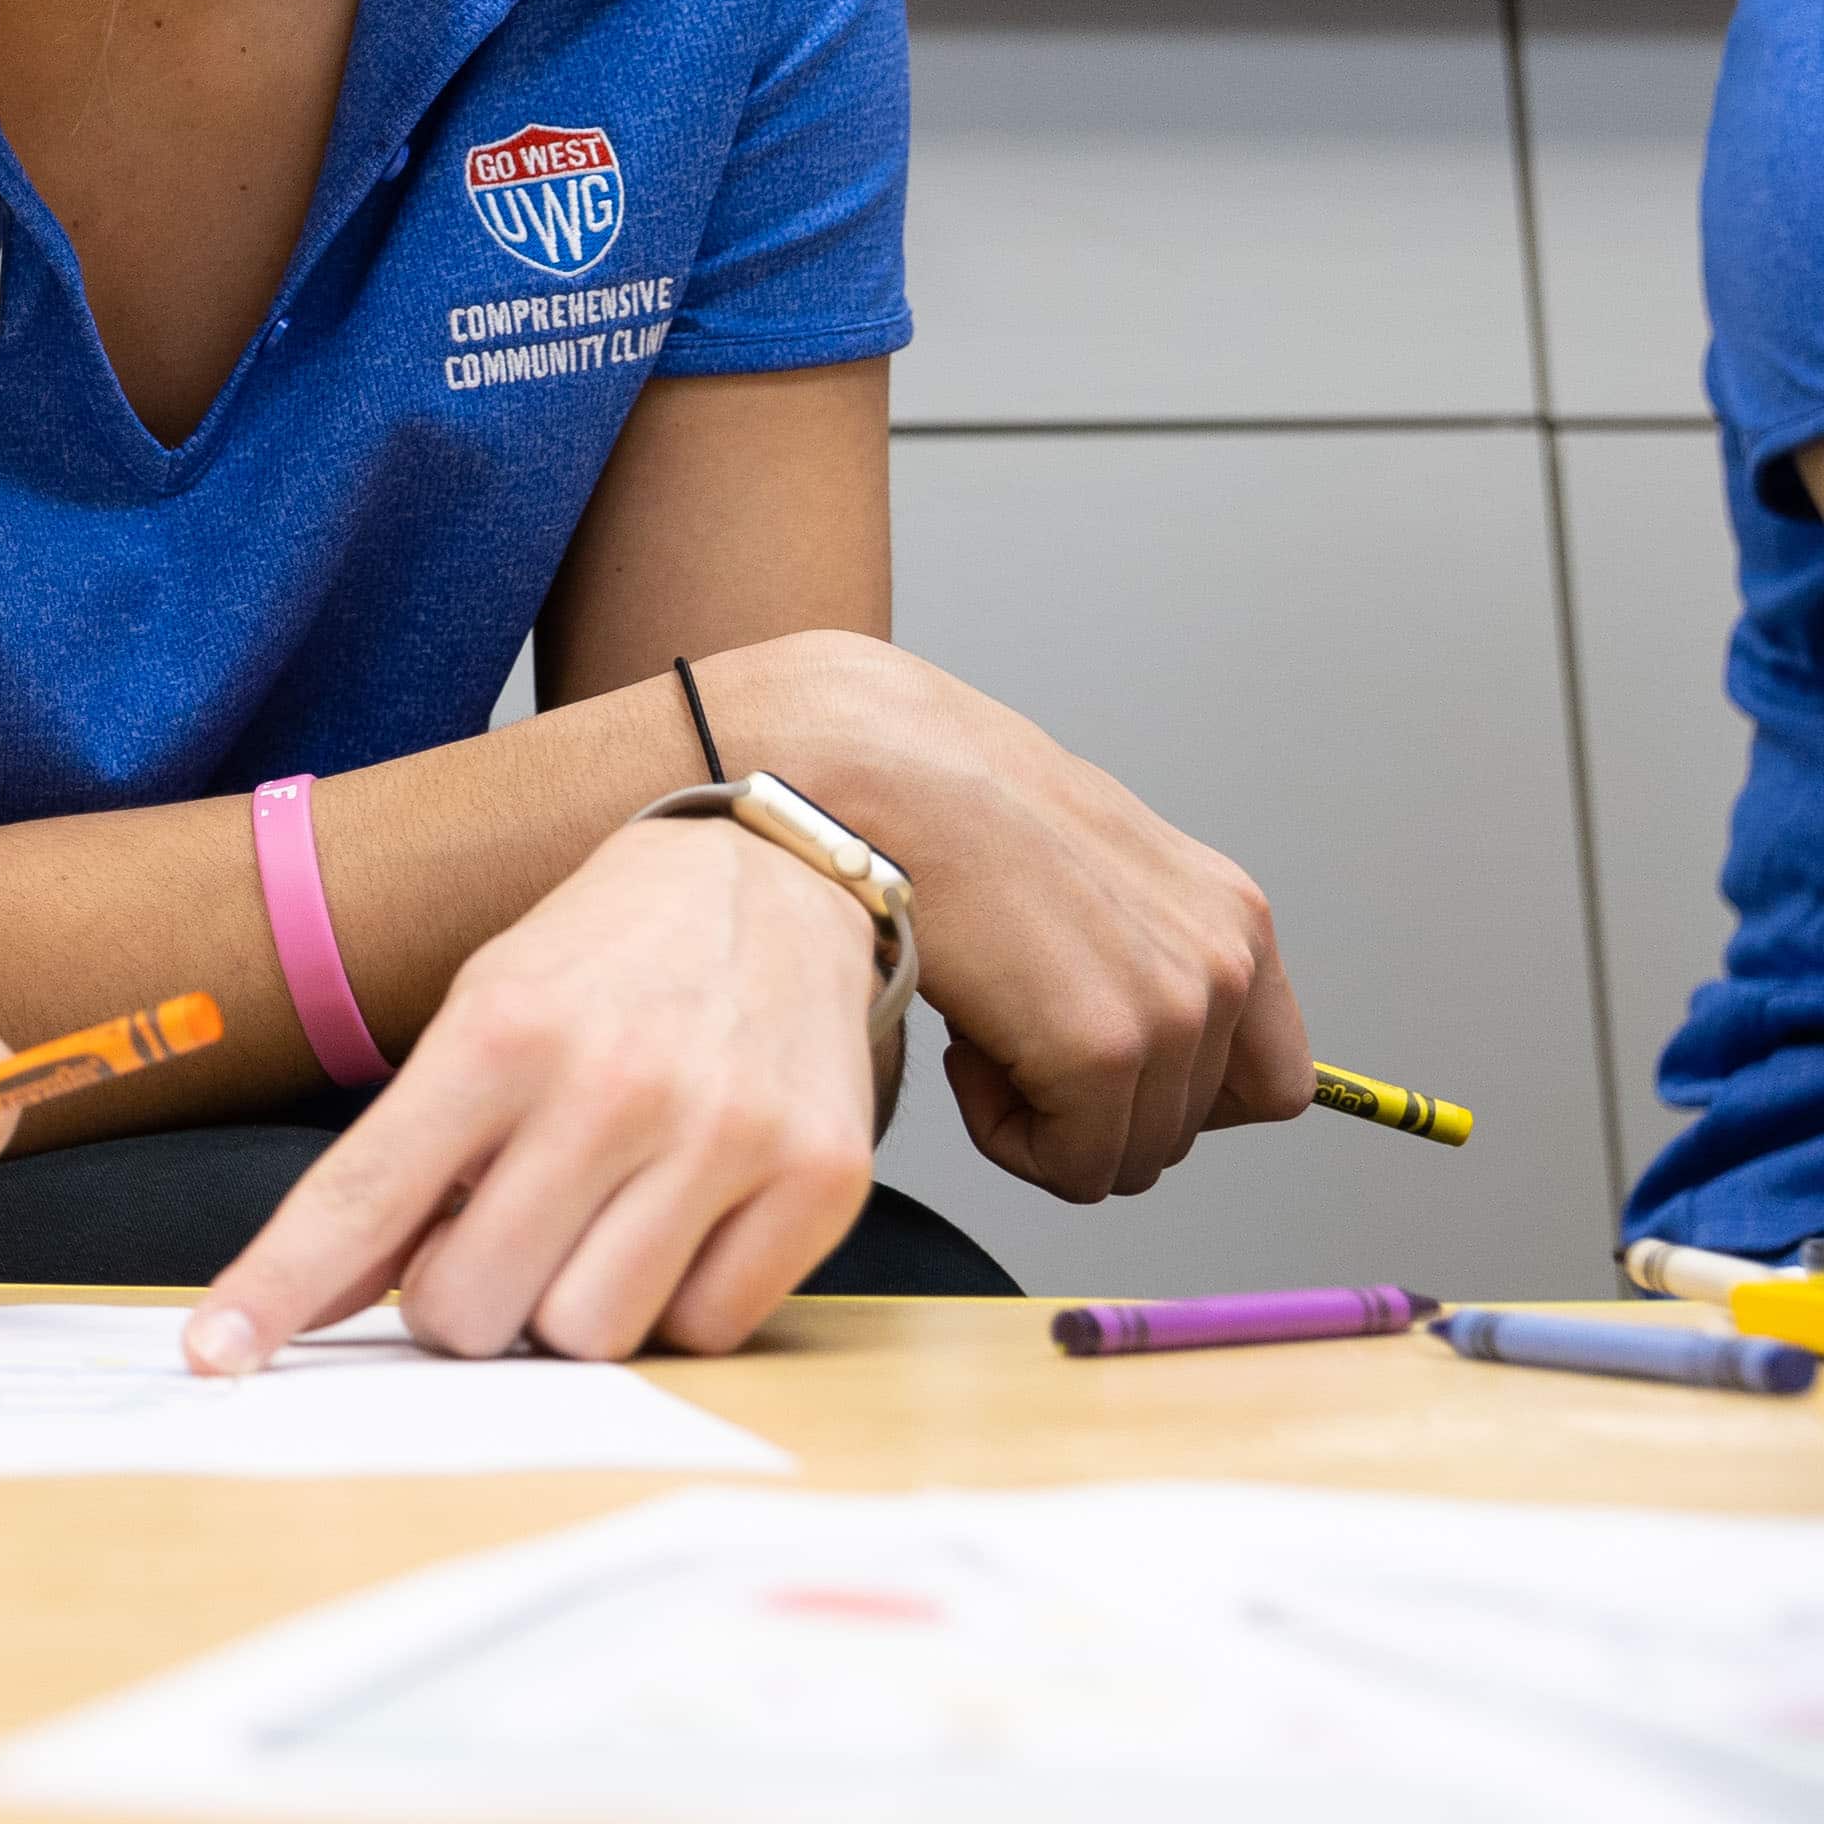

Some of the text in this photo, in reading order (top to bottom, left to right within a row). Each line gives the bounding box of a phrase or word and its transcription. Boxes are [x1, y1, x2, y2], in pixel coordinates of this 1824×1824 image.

[474, 137, 602, 182] GO WEST
[484, 174, 614, 263] UWG
[448, 276, 674, 344] COMPREHENSIVE
[444, 333, 606, 391] COMMUNITY
